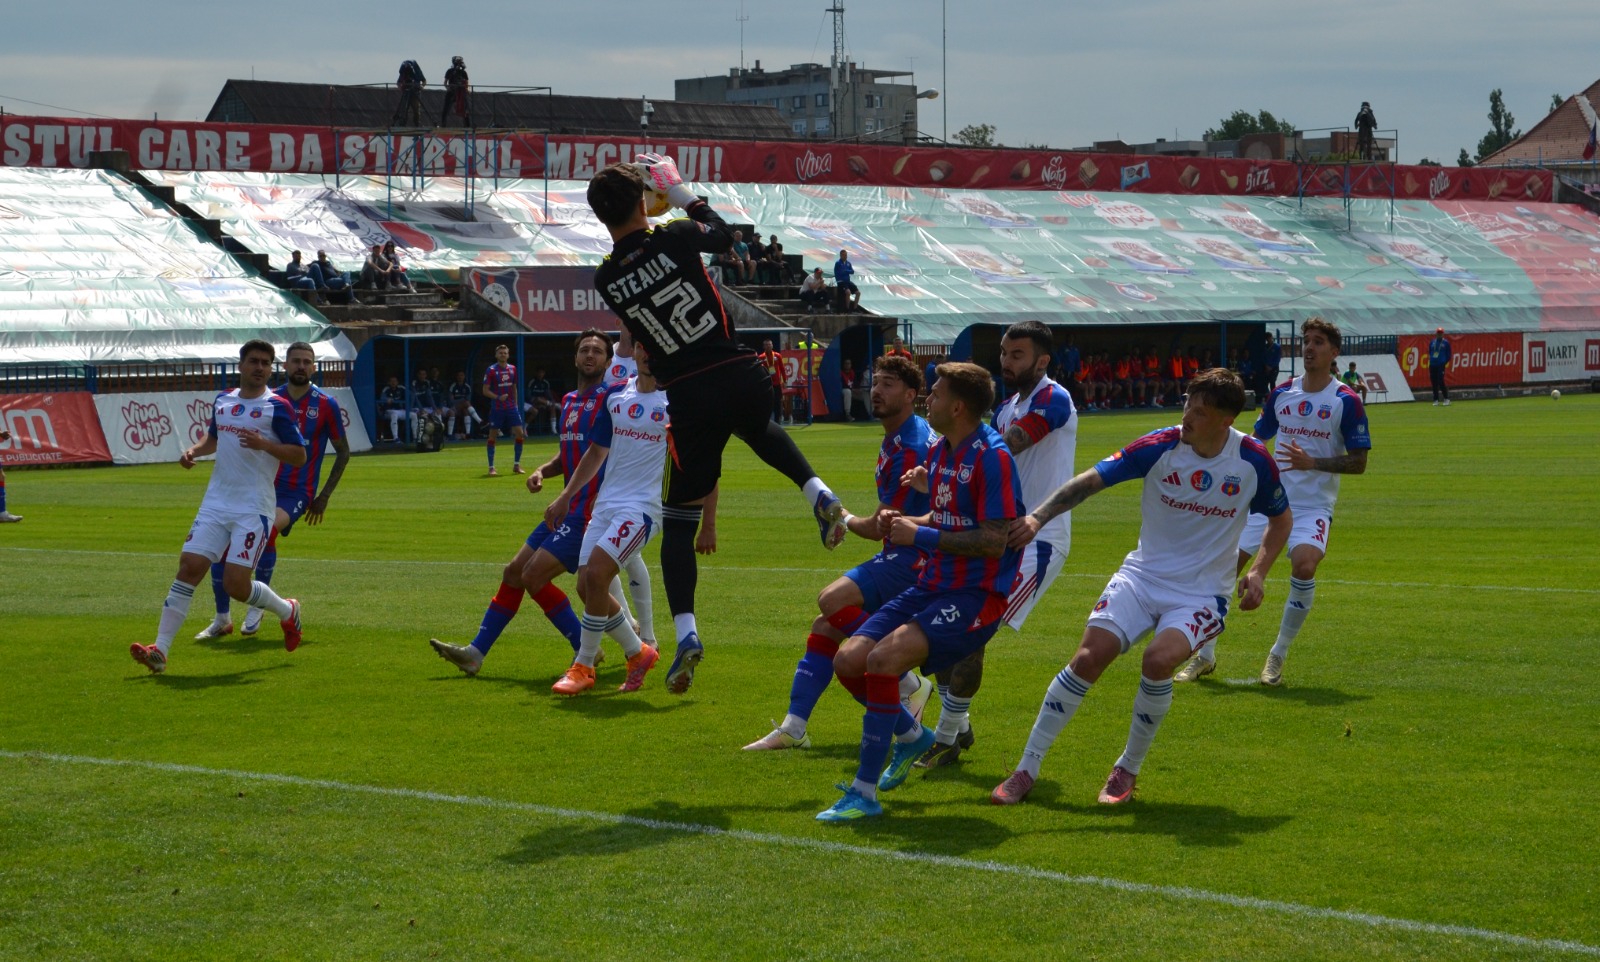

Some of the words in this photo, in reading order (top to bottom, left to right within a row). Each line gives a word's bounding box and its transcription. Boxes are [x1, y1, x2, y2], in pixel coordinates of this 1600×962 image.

[138, 128, 250, 169] CARE
[269, 132, 324, 172] DA
[342, 134, 522, 177] STARTUL
[544, 142, 723, 183] MECIUI!
[796, 150, 832, 181] Viva
[607, 252, 678, 304] STEAUA
[528, 289, 565, 312] HAI
[572, 289, 610, 311] BIH
[625, 277, 718, 356] 12
[1451, 347, 1520, 373] pariurilor
[1547, 344, 1578, 360] MARTY
[122, 400, 160, 427] Viva
[187, 399, 214, 426] Viv
[124, 414, 172, 451] Chips
[613, 426, 662, 443] tanleybet
[6, 452, 63, 462] PUBLICITATE
[1160, 494, 1238, 518] Stanleybet
[556, 523, 571, 537] 32
[617, 520, 635, 539] 6
[1315, 518, 1326, 535] 9
[244, 531, 256, 550] 8
[940, 604, 961, 623] 25
[1192, 606, 1221, 635] 21
